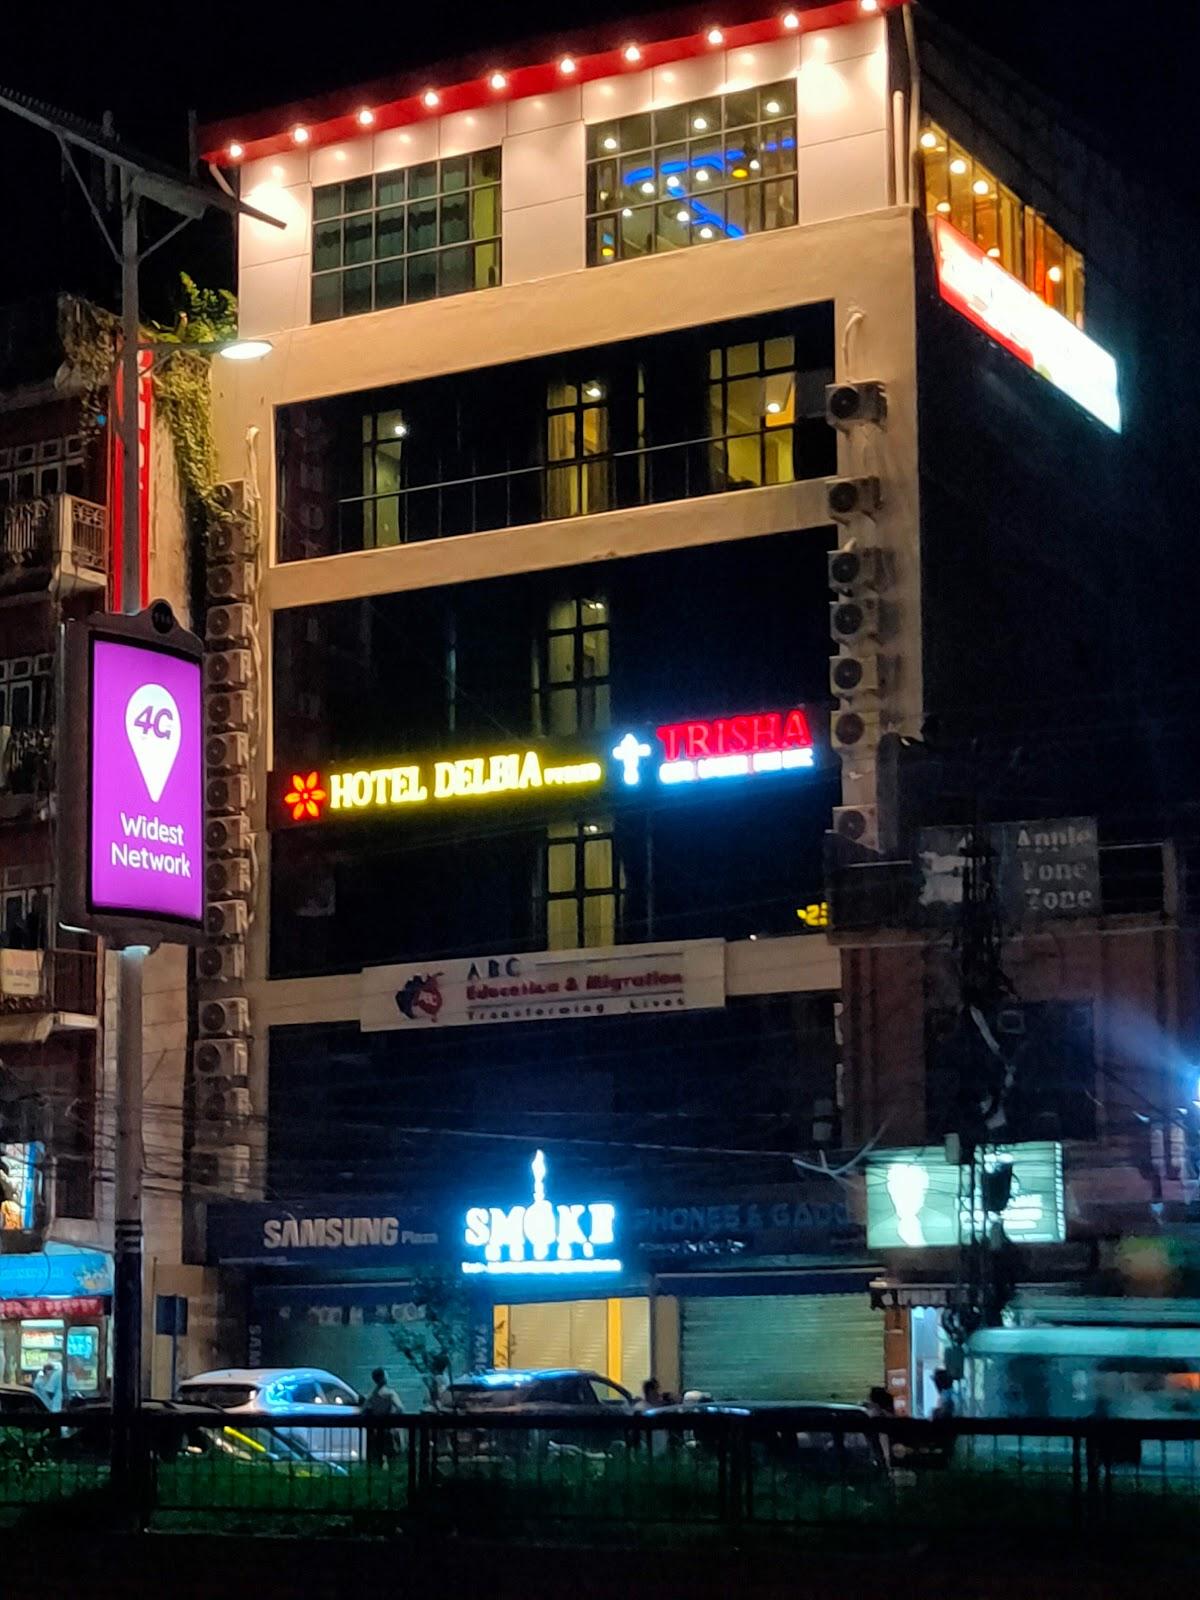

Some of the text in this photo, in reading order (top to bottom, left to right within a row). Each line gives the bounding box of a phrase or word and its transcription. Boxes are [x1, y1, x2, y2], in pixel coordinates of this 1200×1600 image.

[134, 706, 173, 740] 4G
[657, 711, 812, 762] TRISHA
[330, 766, 428, 808] HOTEL
[120, 812, 184, 846] Widest
[111, 842, 192, 878] Network
[468, 957, 521, 981] ABC
[564, 977, 578, 991] &
[263, 1216, 399, 1249] SAMSUNG
